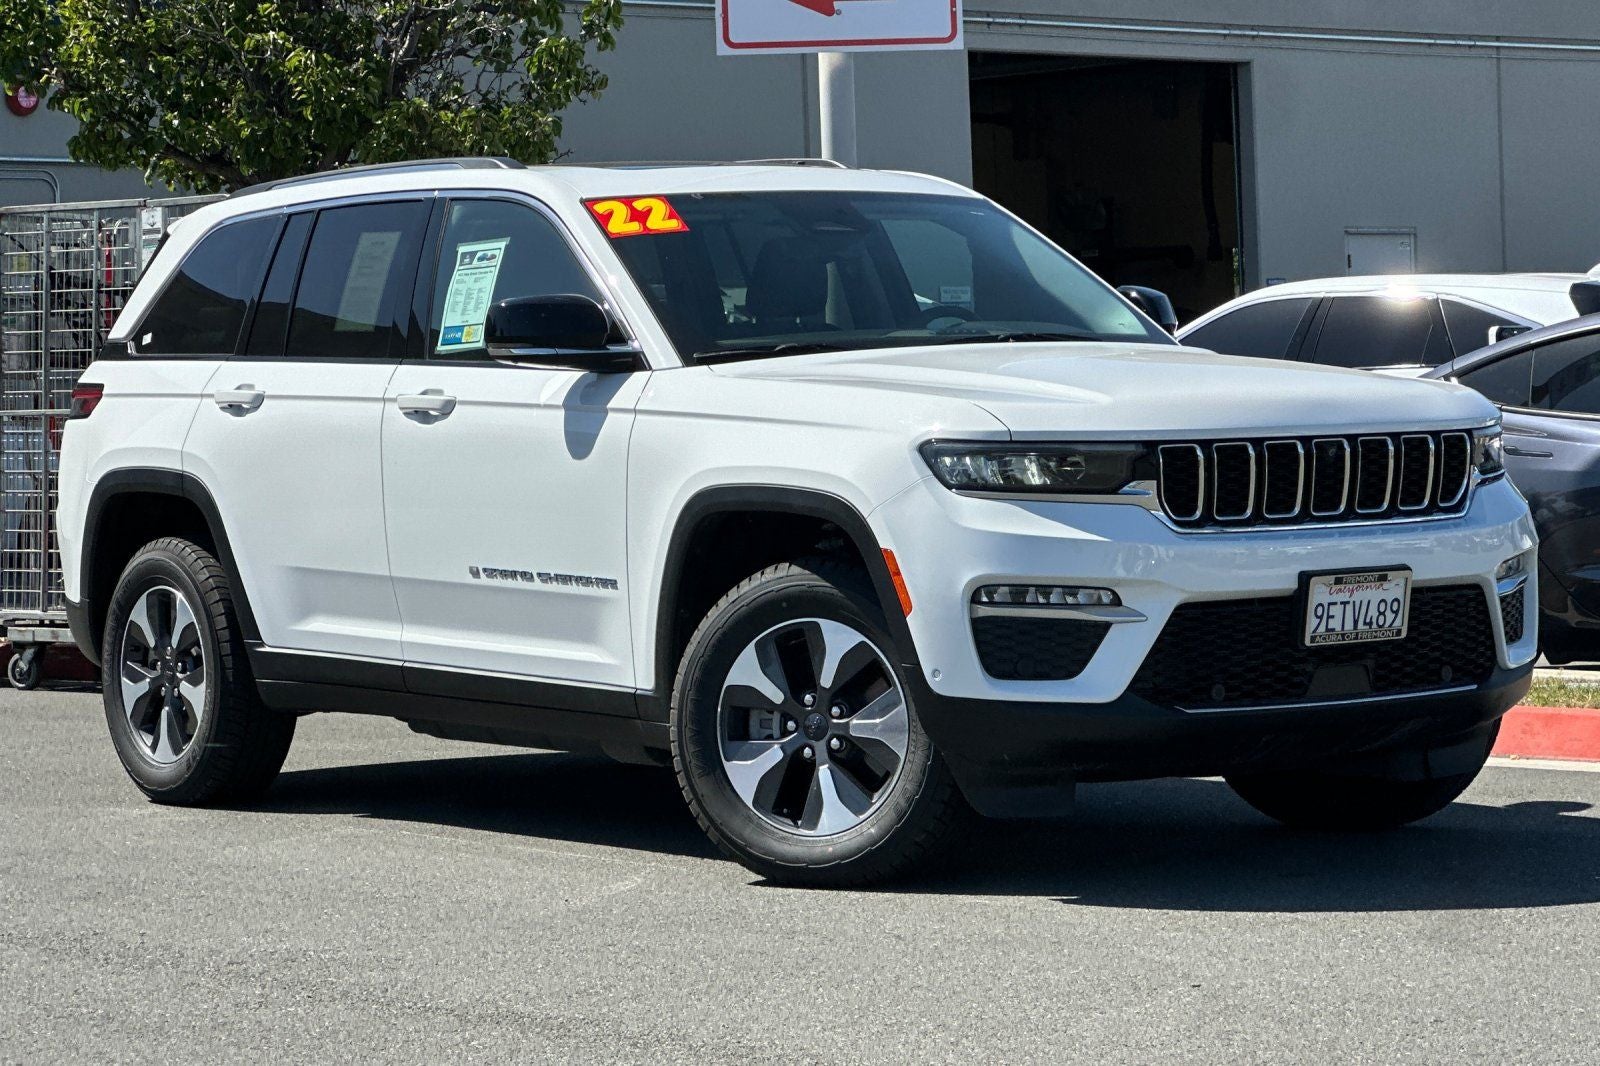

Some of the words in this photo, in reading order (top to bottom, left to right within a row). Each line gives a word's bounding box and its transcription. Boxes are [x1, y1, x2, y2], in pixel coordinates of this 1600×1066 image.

[592, 197, 683, 234] 22
[1343, 575, 1379, 585] FREMONT
[1312, 597, 1401, 634] 9ETV489
[1315, 634, 1342, 644] ACURA
[1344, 632, 1357, 641] OF
[1358, 630, 1398, 640] FREMONT
